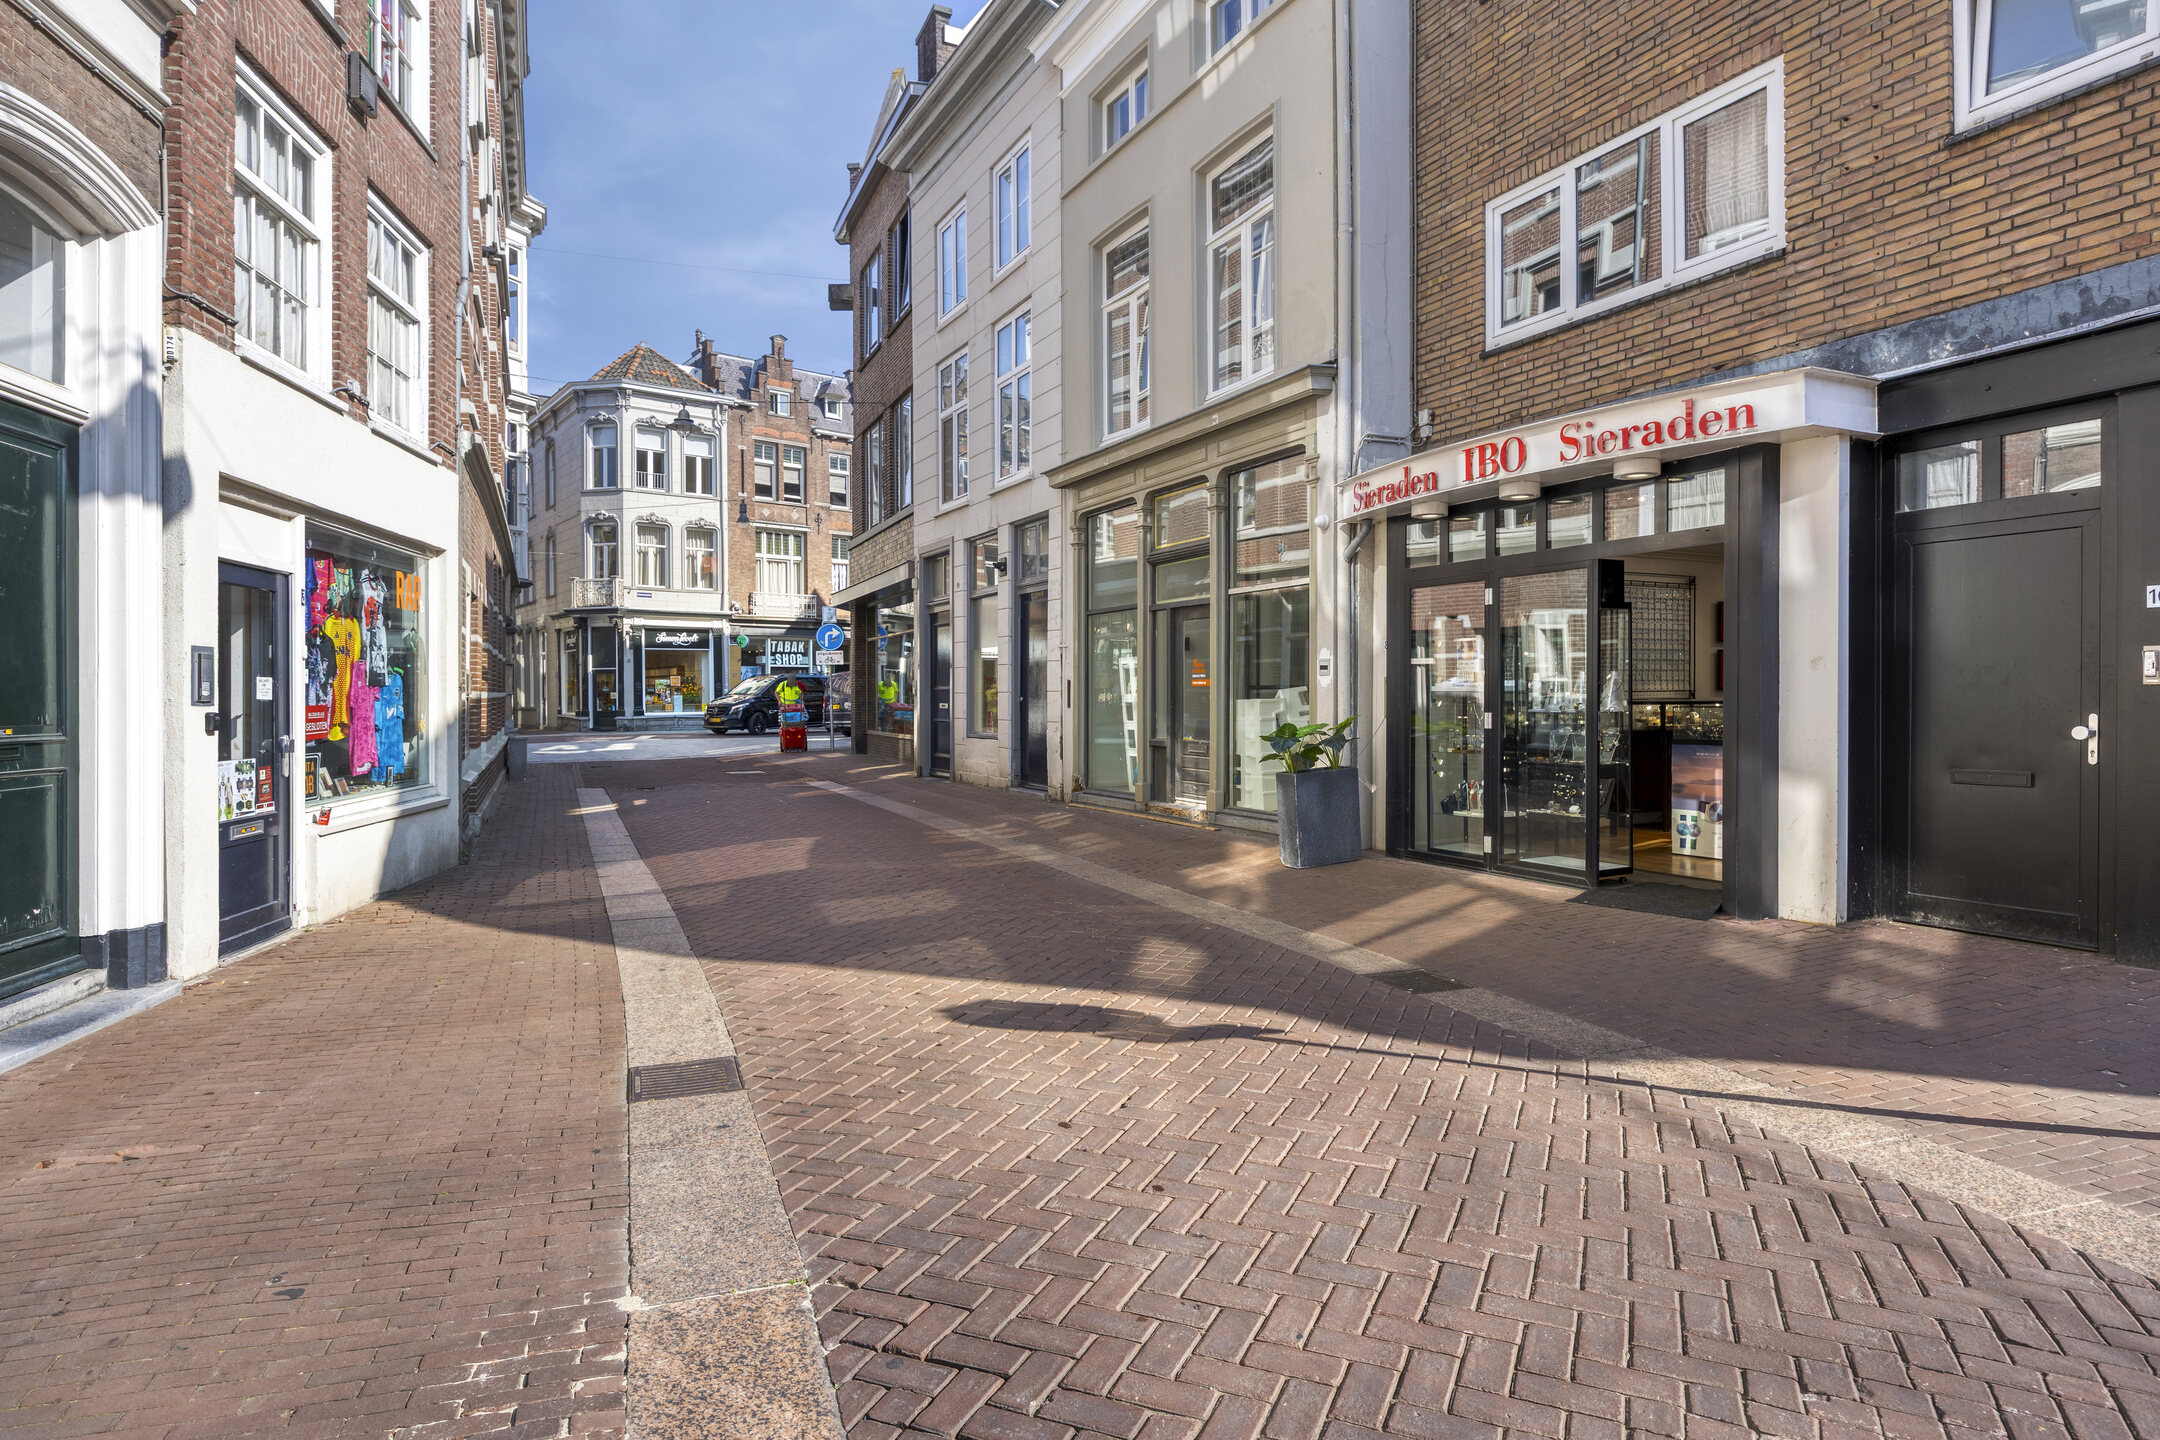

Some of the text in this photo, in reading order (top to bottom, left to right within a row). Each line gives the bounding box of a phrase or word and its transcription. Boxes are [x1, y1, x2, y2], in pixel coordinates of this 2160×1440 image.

[1353, 398, 1759, 513] Sieraden IBO Sieraden
[2149, 588, 2160, 604] 1
[771, 640, 805, 653] TABAK
[775, 653, 802, 665] SHOP
[305, 720, 328, 732] GESLOTEN
